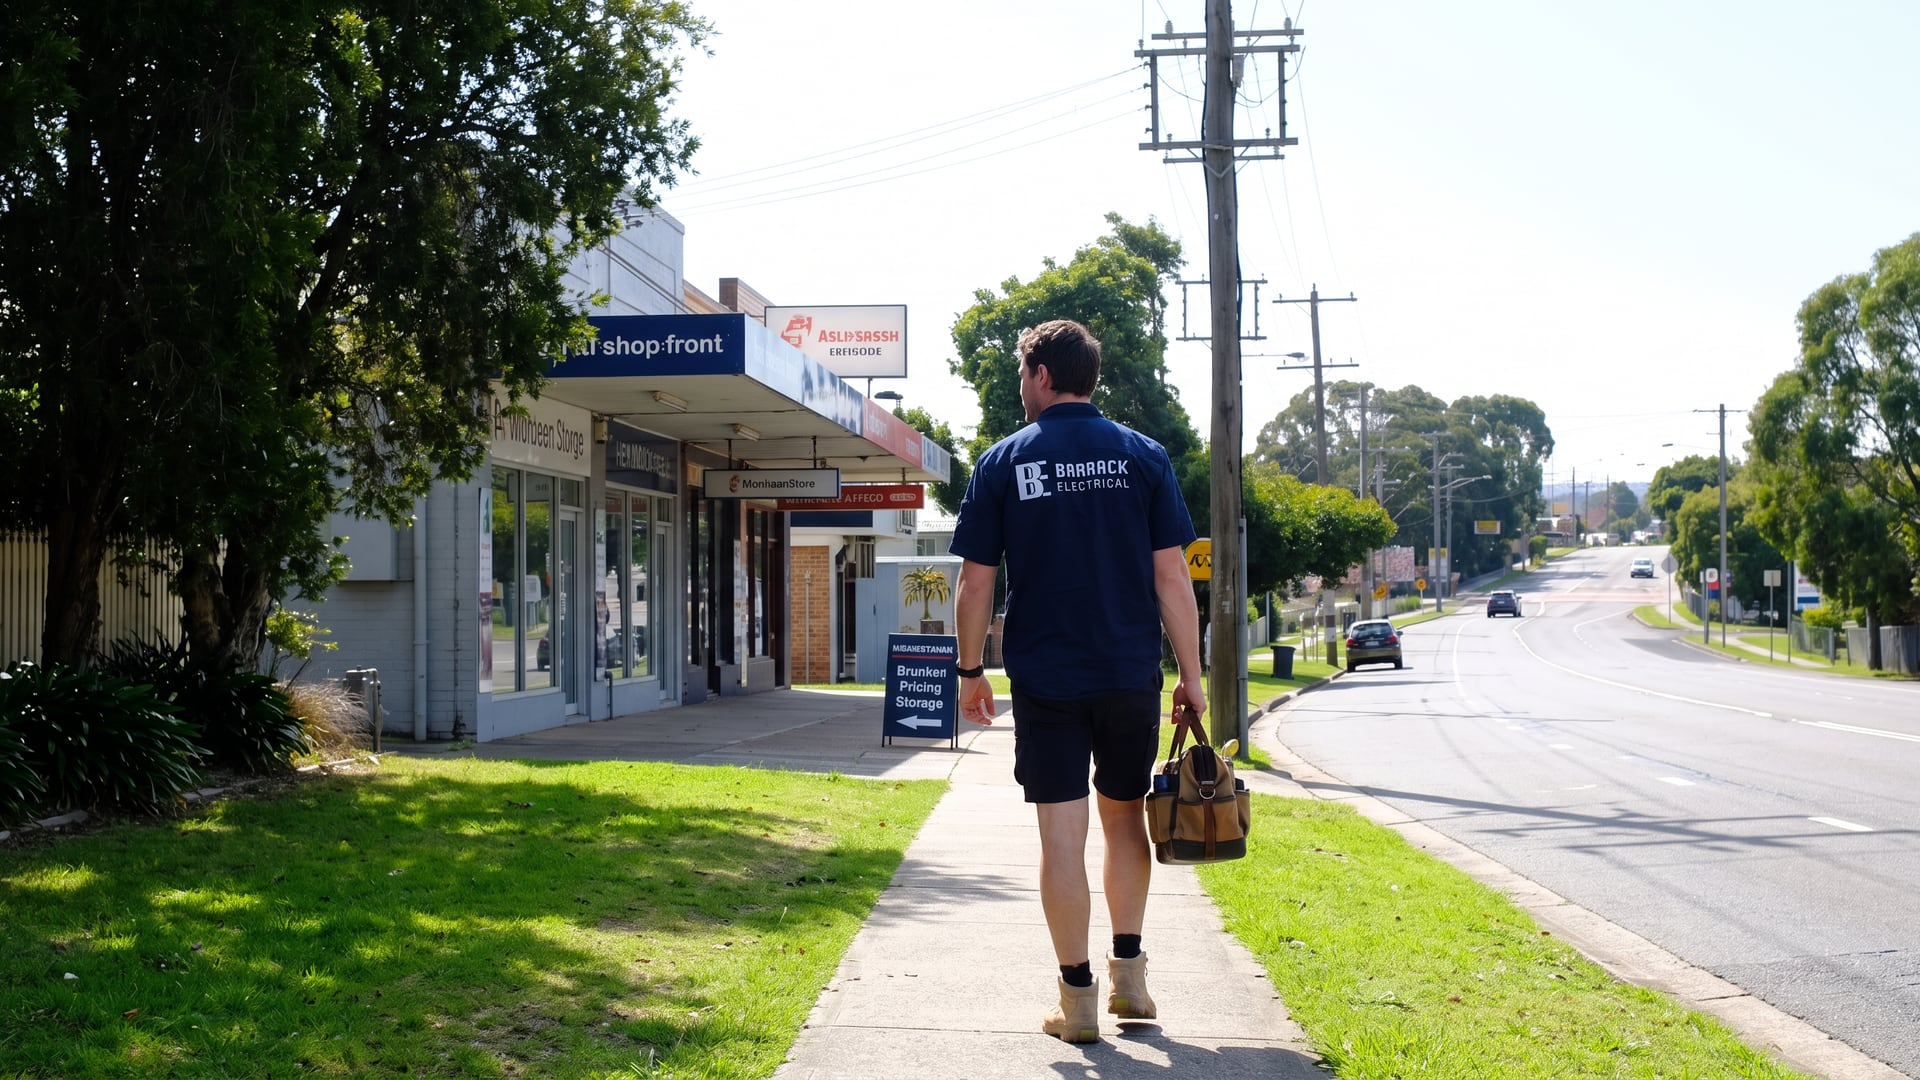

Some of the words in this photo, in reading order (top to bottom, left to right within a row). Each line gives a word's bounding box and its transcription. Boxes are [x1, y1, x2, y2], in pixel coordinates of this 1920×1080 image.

[556, 418, 584, 460] Storge
[1055, 460, 1129, 478] BARRACK
[1057, 478, 1130, 492] ELECTRICAL
[899, 681, 942, 696] Pricing
[896, 696, 944, 712] Storage
